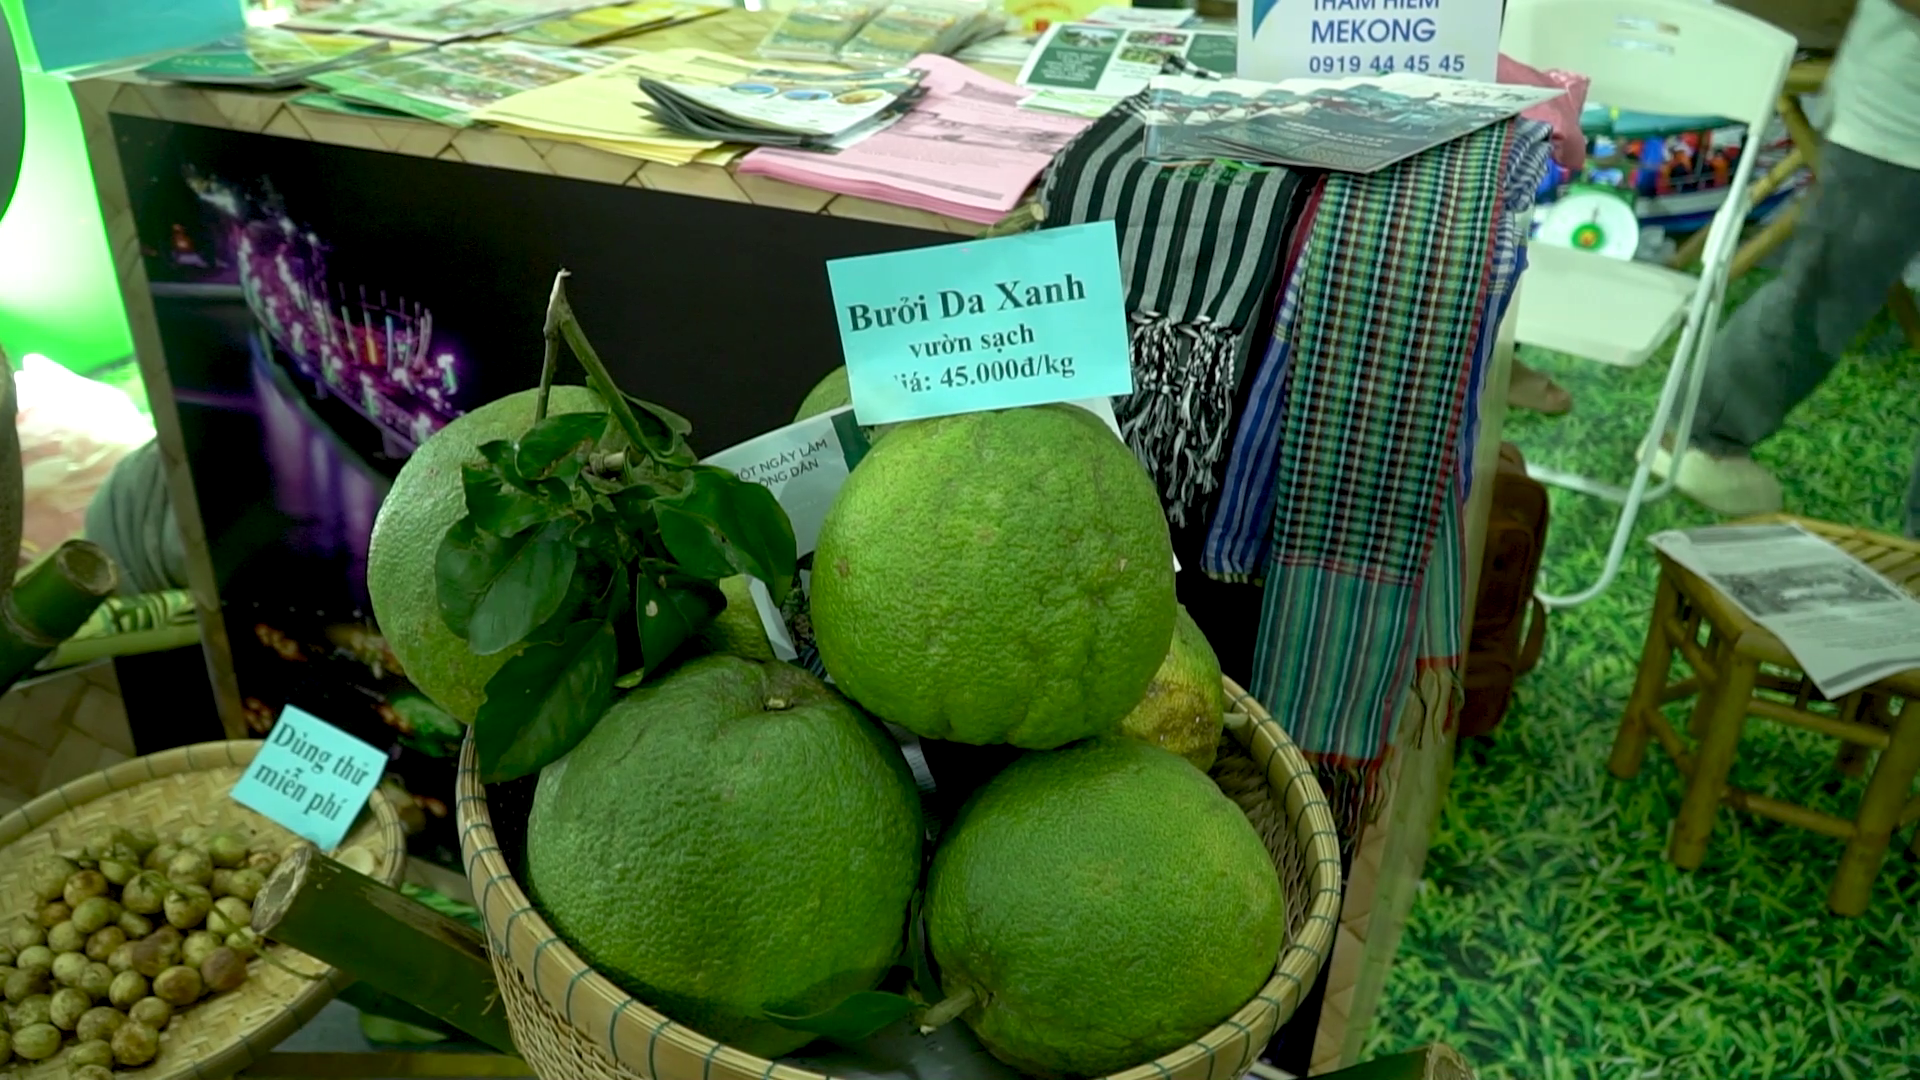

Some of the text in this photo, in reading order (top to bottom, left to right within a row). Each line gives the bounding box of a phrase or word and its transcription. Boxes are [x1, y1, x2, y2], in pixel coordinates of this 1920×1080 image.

[1311, 18, 1437, 43] MEKONG
[1309, 54, 1465, 73] 0919 44 45 45
[846, 273, 1086, 332] Bưởi Da Xanh
[909, 323, 1035, 359] vườn sạch
[893, 354, 1076, 393] iá: 45.000đ/kg
[332, 756, 370, 787] thử
[253, 764, 349, 821] miễn phí
